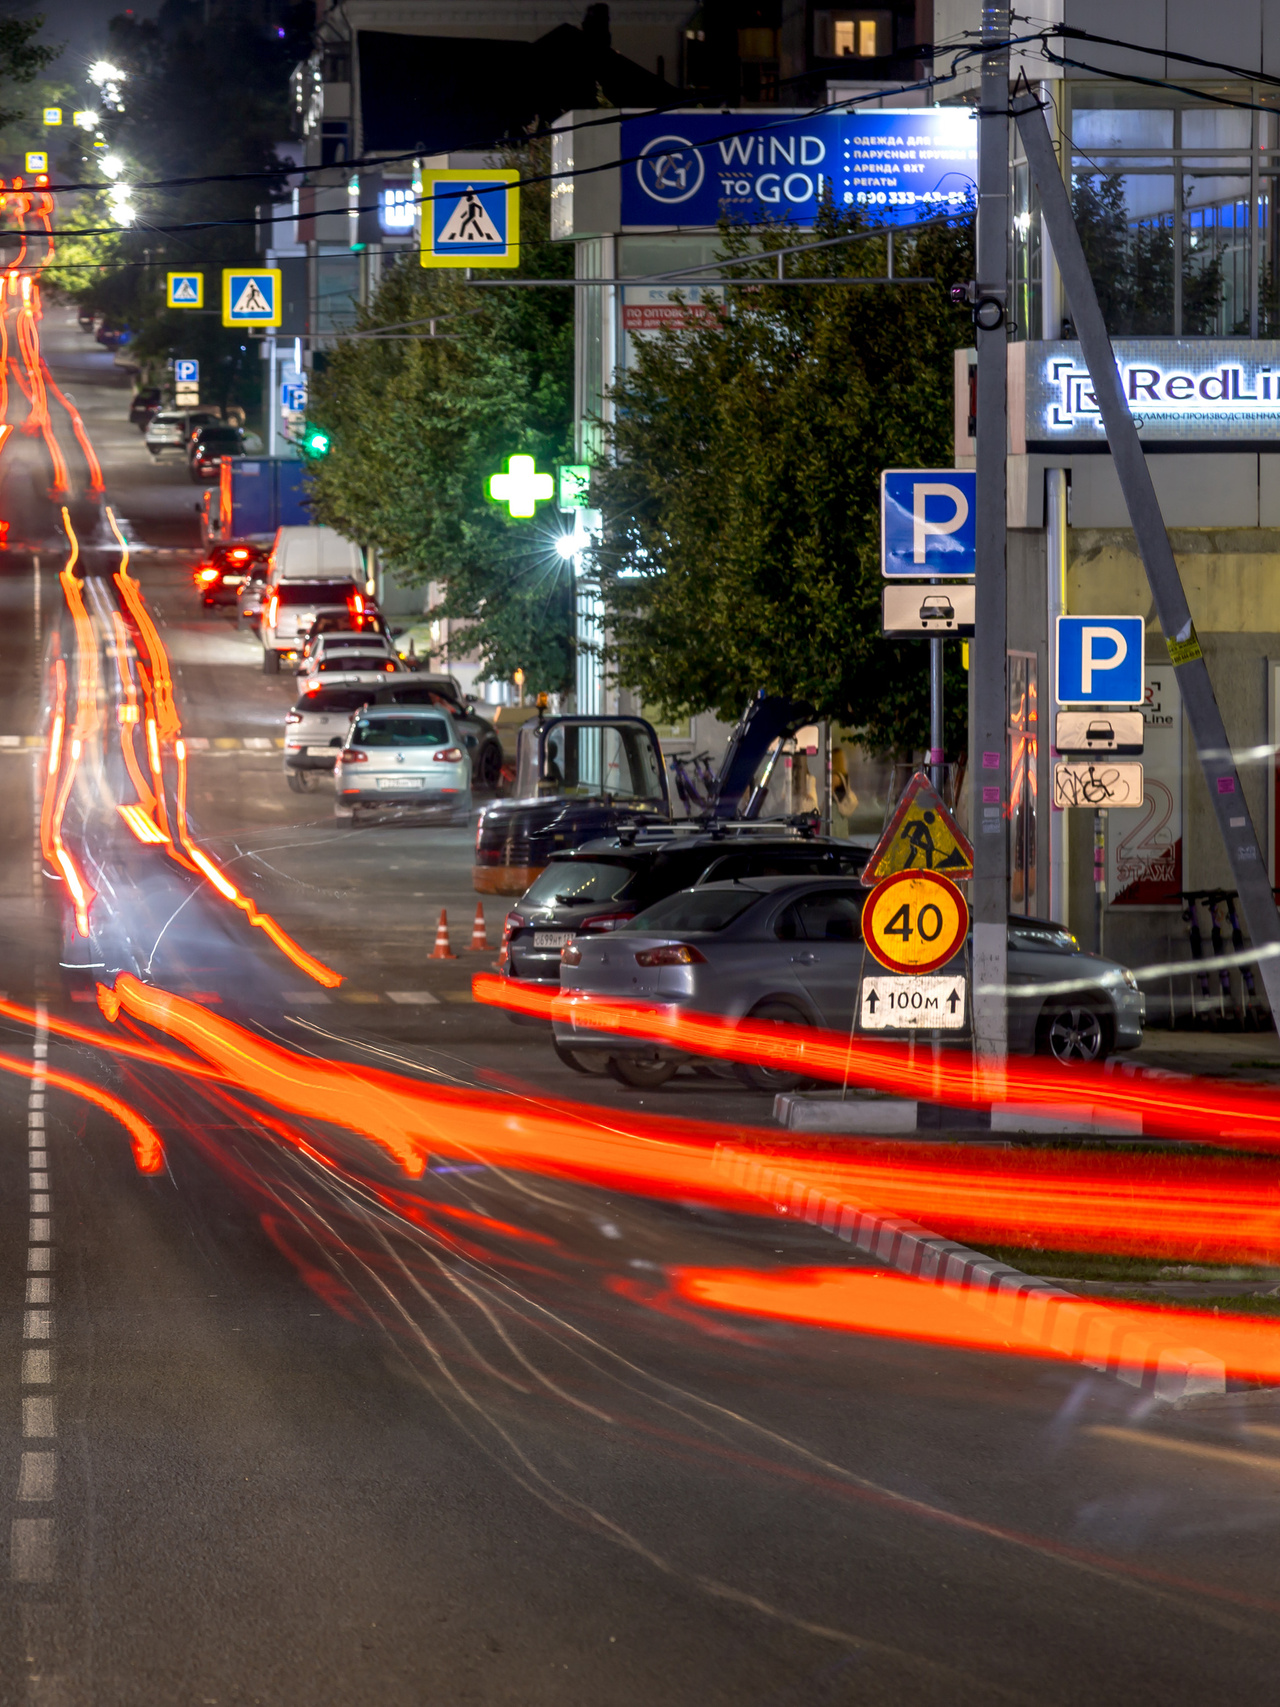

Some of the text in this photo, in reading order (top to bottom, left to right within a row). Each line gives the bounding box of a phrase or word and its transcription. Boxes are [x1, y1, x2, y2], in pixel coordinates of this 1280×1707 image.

[853, 136, 904, 146] ОДЕЖДА
[853, 150, 916, 159] ПАРУСНЫЕ
[853, 164, 926, 174] АРЕНДА ЯХТ
[721, 180, 751, 196] TO
[853, 178, 897, 187] РЕГАТЫ
[1128, 368, 1280, 400] RedLi
[913, 482, 969, 564] P
[1081, 626, 1128, 694] P
[1116, 864, 1175, 882] ЭТАЖ
[883, 903, 943, 942] 40
